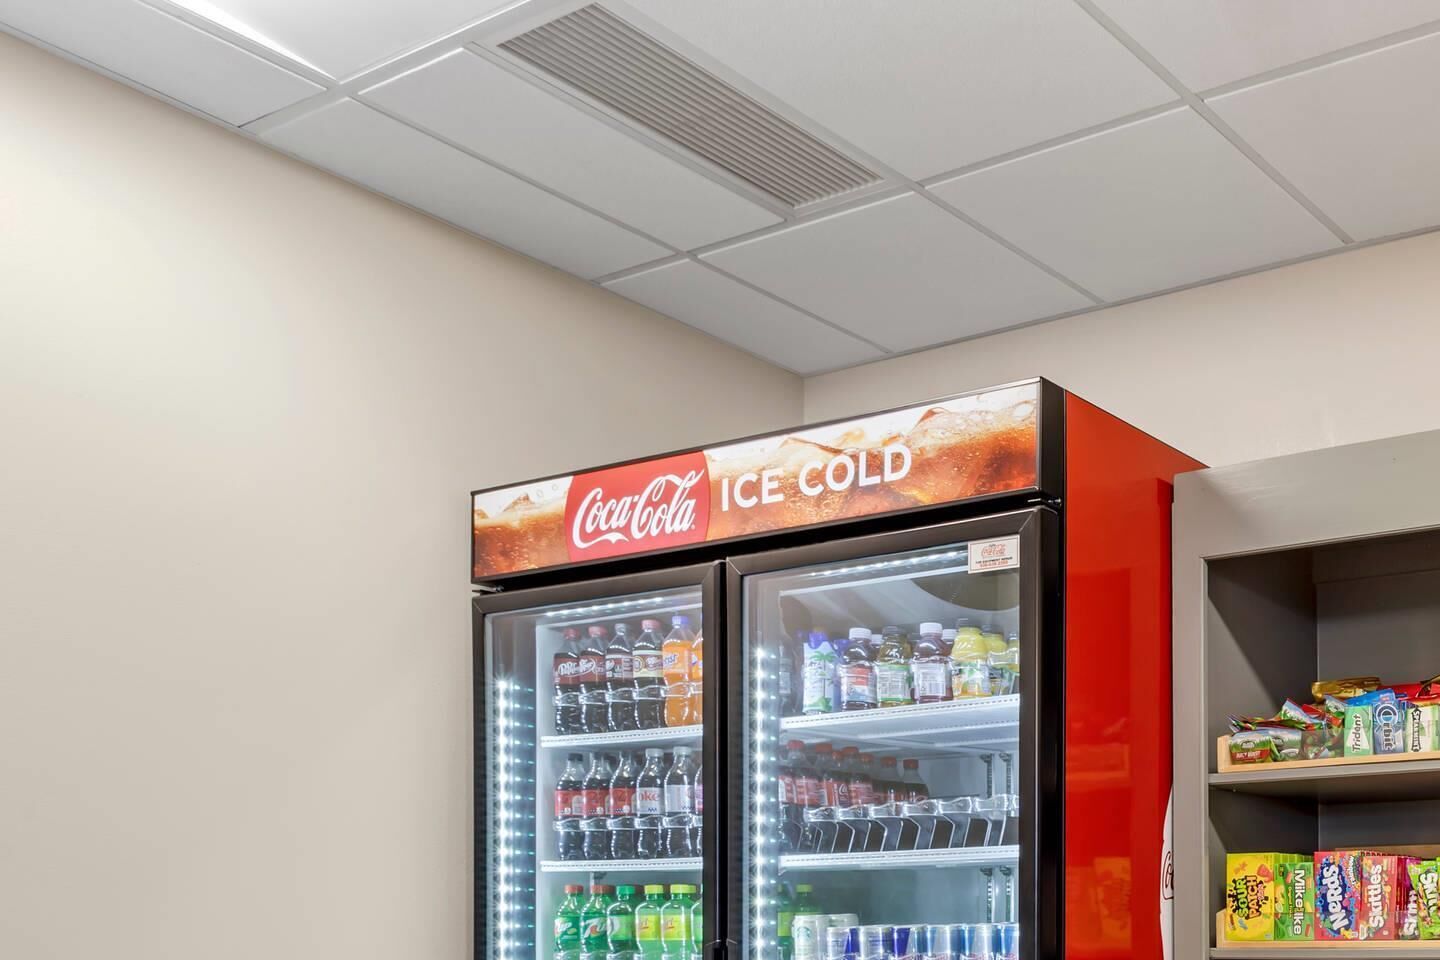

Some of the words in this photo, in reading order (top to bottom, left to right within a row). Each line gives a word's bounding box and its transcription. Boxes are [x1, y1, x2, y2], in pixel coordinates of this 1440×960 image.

[721, 466, 785, 512] ICE
[797, 445, 913, 492] COLD
[572, 467, 705, 550] Coca-Cola
[1352, 713, 1361, 753] Trident
[1375, 702, 1398, 752] Orbit
[1293, 868, 1305, 908] Mike
[1349, 856, 1357, 885] rainbow
[1236, 879, 1248, 919] SOUR
[1247, 874, 1259, 920] PATCH
[1368, 864, 1384, 928] Skittles
[1293, 911, 1304, 935] Ike
